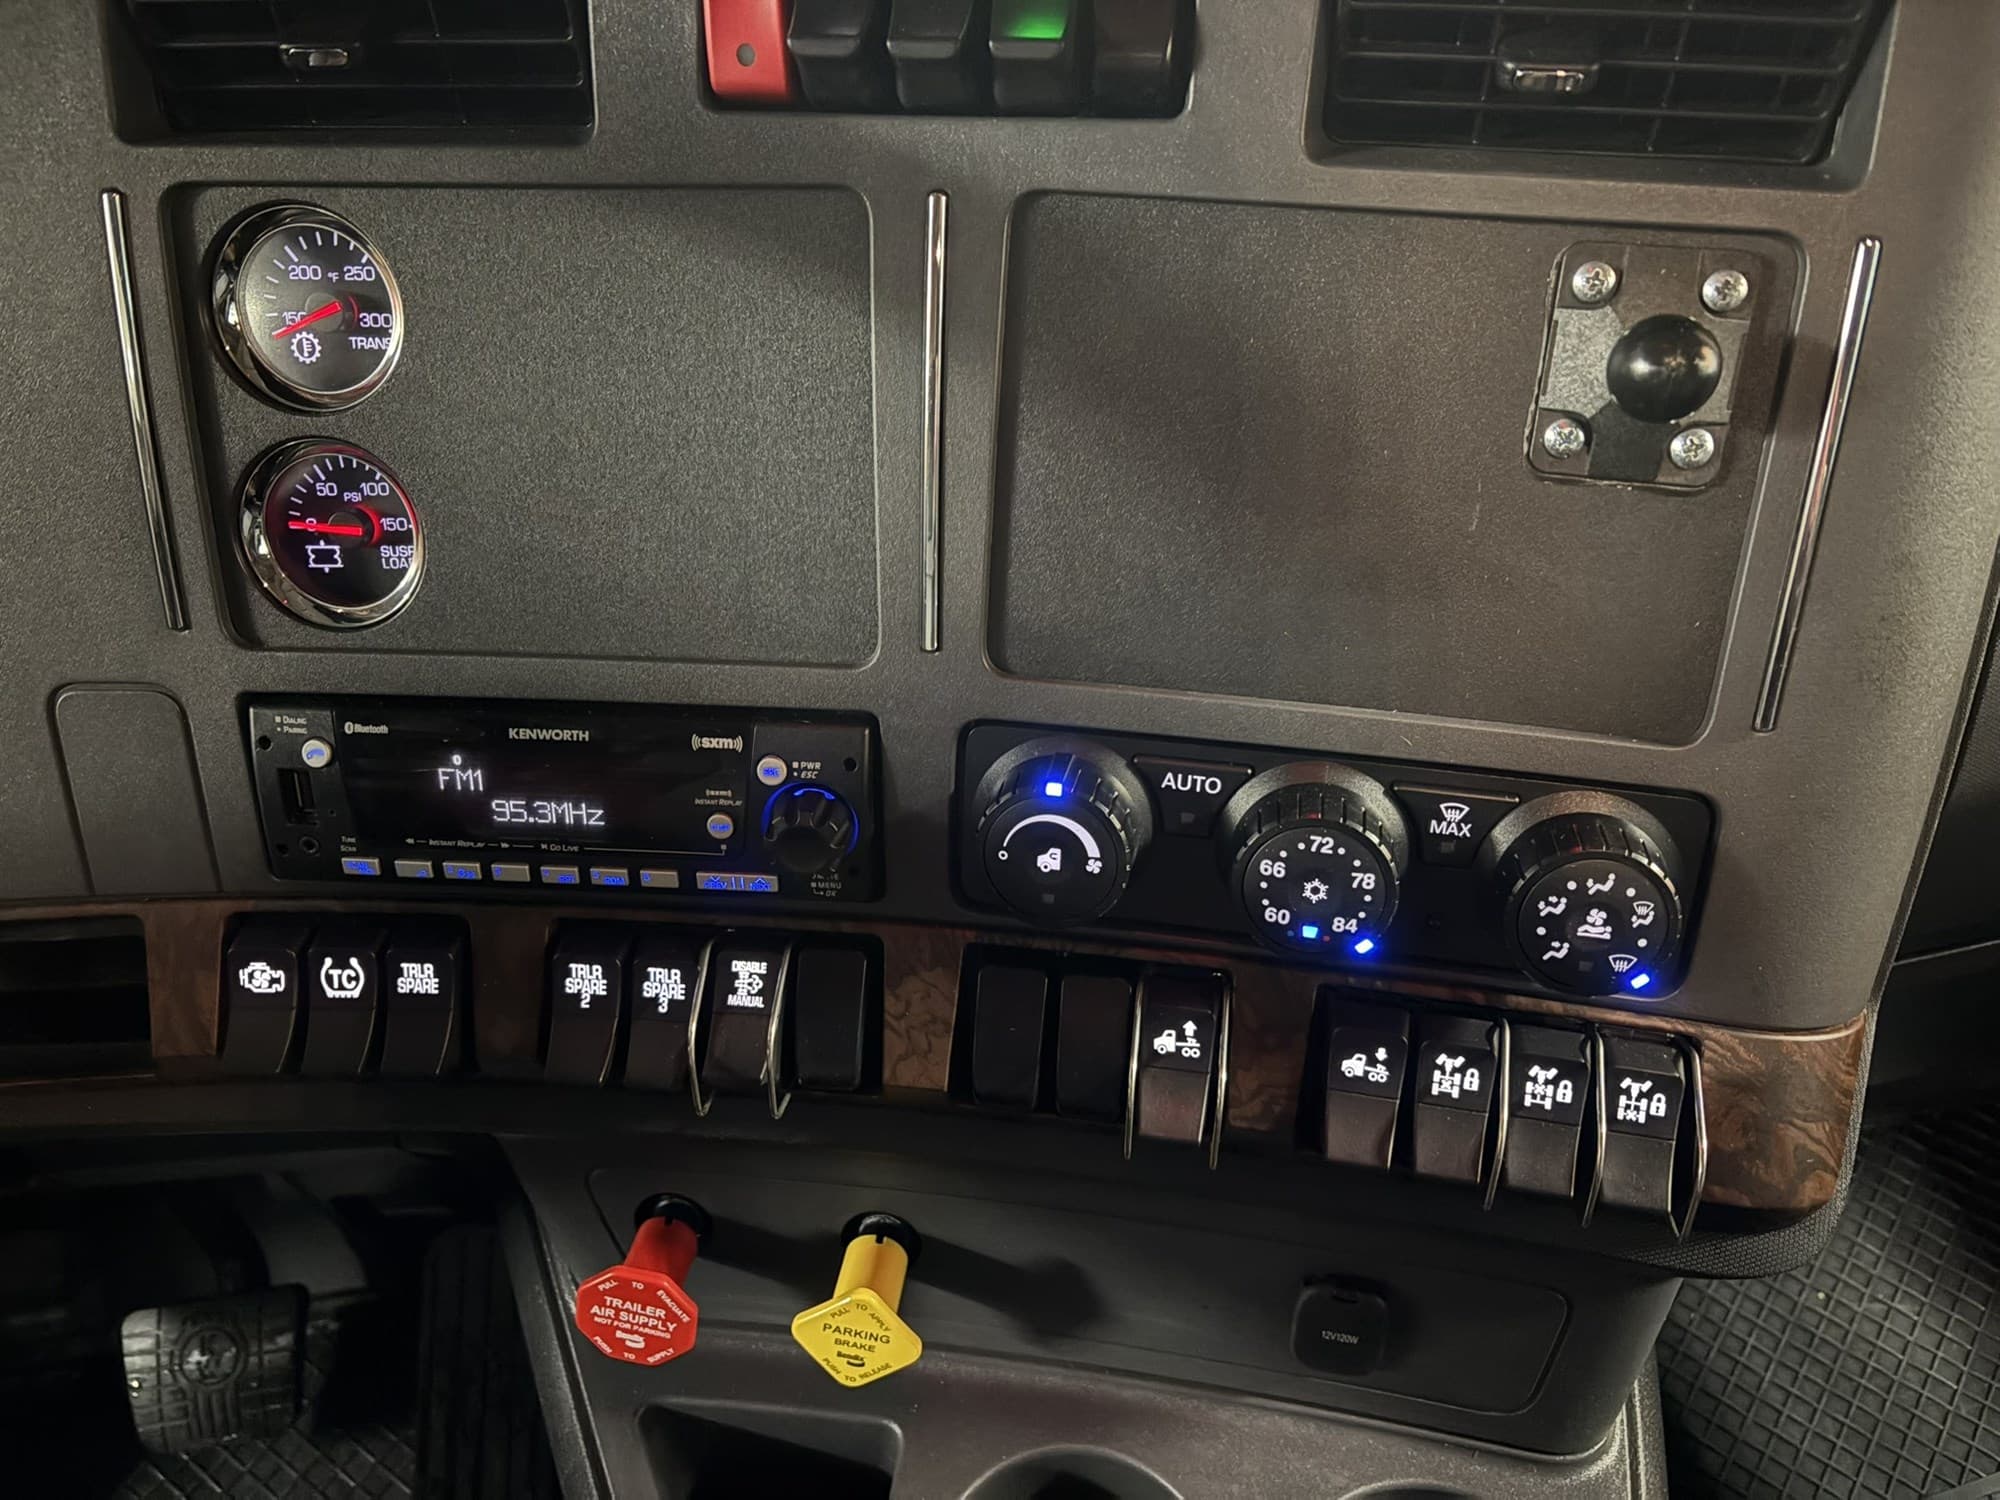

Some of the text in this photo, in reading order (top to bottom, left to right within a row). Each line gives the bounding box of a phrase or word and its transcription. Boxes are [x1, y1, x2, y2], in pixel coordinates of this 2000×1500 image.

[288, 265, 322, 280] 200
[343, 265, 376, 281] 250
[359, 312, 392, 328] 300
[315, 482, 338, 496] 50
[359, 482, 390, 497] 100
[343, 492, 362, 503] PSI
[379, 517, 408, 531] 150
[508, 727, 589, 742] KENWORTH
[800, 761, 822, 770] PWR
[438, 768, 484, 792] FM1
[800, 771, 819, 779] ESC
[1160, 771, 1222, 794] AUTO
[491, 799, 606, 825] 95.3MHz
[1429, 819, 1473, 838] MAX
[1309, 835, 1335, 855] 72
[1259, 859, 1286, 878] 66
[1350, 872, 1376, 890] 78
[1264, 907, 1291, 925] 60
[1331, 917, 1359, 934] 84
[400, 962, 435, 978] TRLR
[568, 963, 603, 980] TRLR
[731, 960, 768, 974] DISABLE
[328, 969, 357, 989] TC
[646, 967, 682, 984] TRLR
[397, 977, 440, 994] SPARE
[564, 977, 607, 996] SPARE
[642, 981, 686, 1000] SPARE
[580, 993, 591, 1009] 2
[657, 997, 669, 1013] 3
[726, 994, 765, 1008] MANUAL
[631, 1281, 644, 1290] TO
[604, 1296, 666, 1319] TRAILER
[855, 1303, 868, 1311] TO
[590, 1305, 678, 1332] AIR SUPPLY
[593, 1316, 612, 1326] NOT
[613, 1320, 631, 1330] FOR
[632, 1324, 672, 1339] PARKING
[822, 1322, 891, 1345] PARKING
[834, 1338, 877, 1353] BRAKE
[623, 1352, 636, 1360] TO
[844, 1375, 857, 1383] TO
